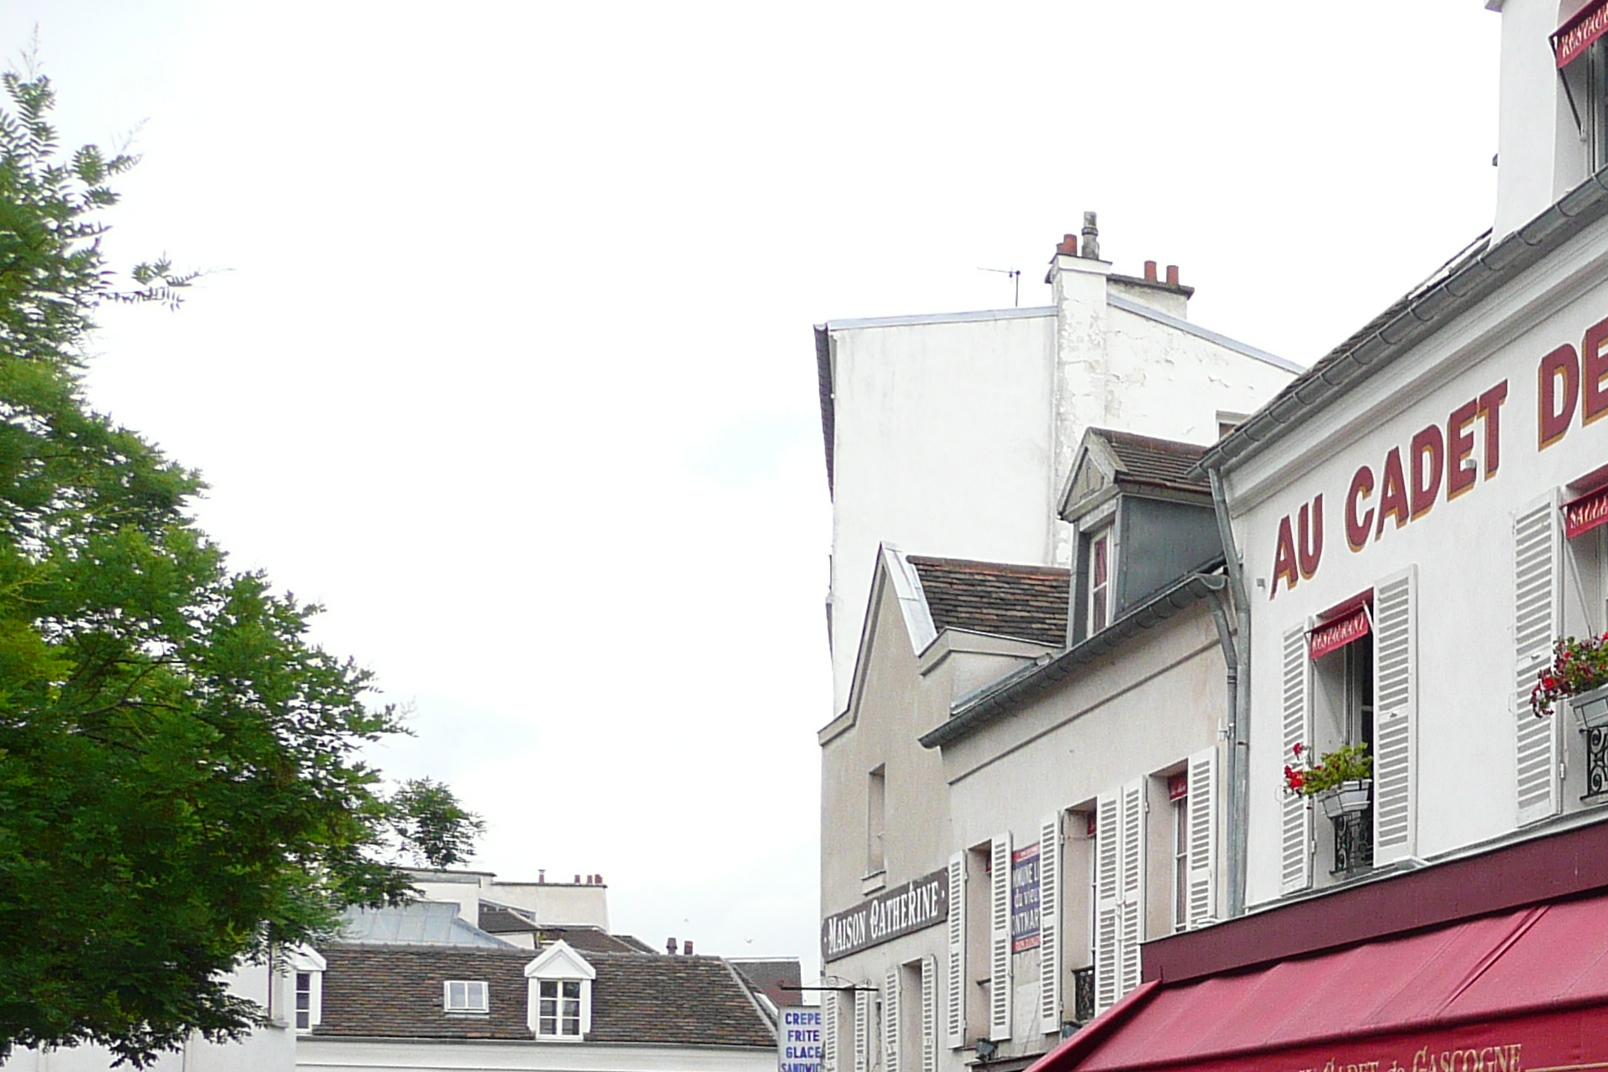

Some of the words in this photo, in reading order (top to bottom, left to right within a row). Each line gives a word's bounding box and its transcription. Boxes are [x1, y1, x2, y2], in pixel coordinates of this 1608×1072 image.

[1270, 493, 1324, 600] AU
[1345, 378, 1508, 553] CADET
[1312, 611, 1366, 652] RESTAURANT
[828, 911, 866, 954] MAISON
[870, 881, 939, 938] CATHERINE
[787, 1030, 820, 1042] FRITE
